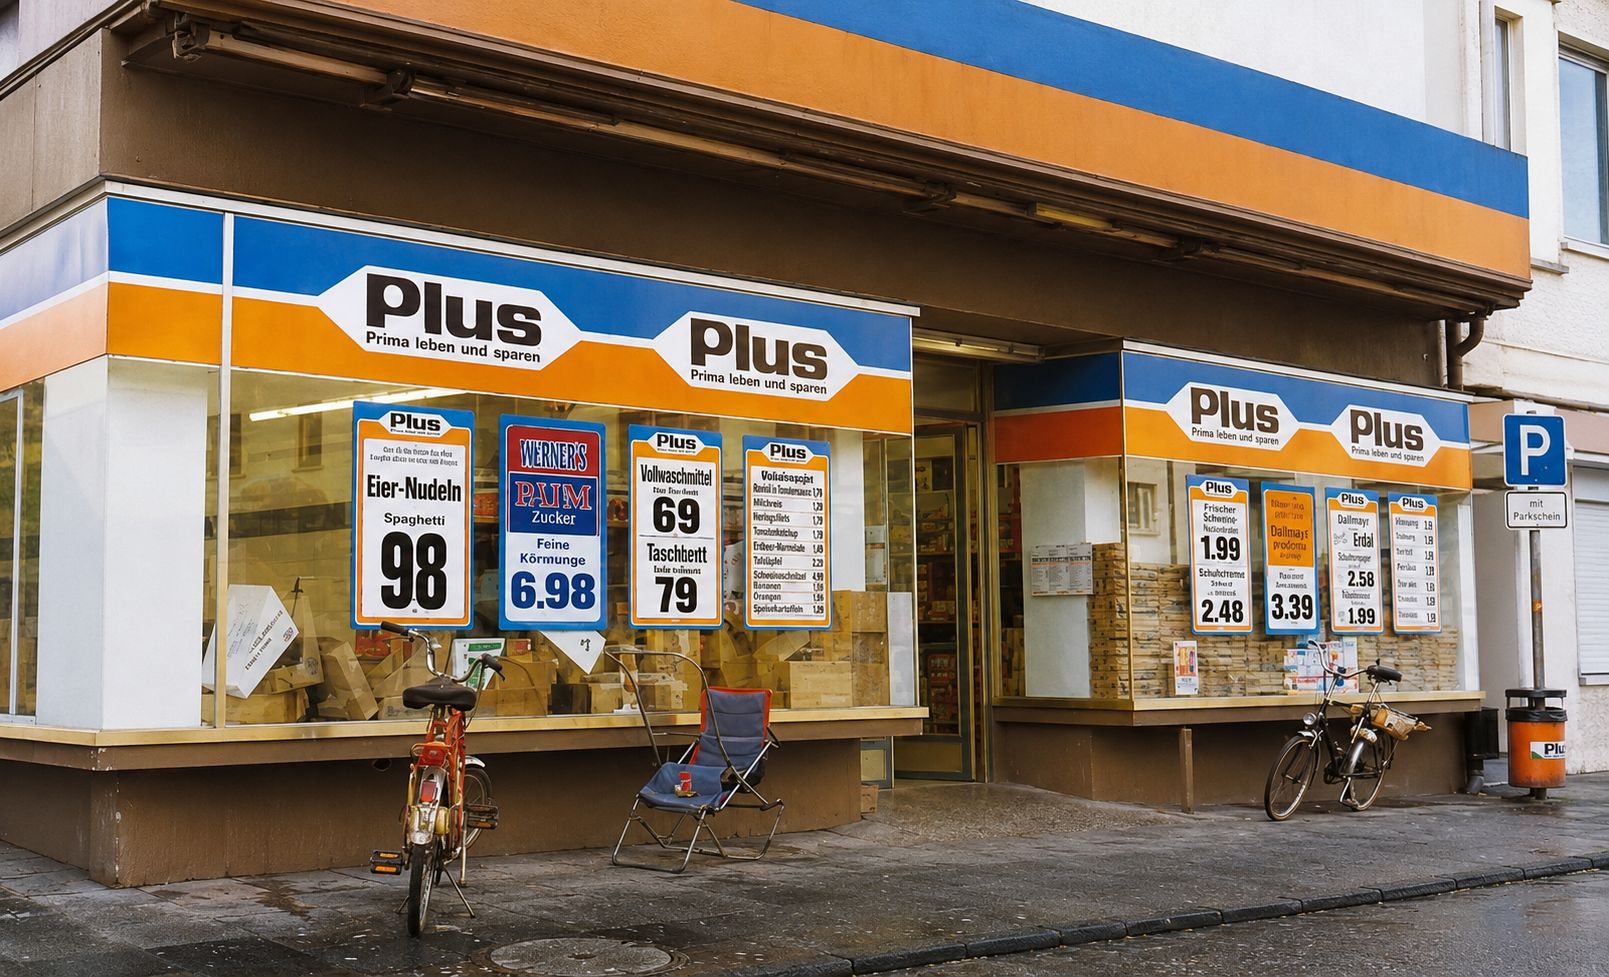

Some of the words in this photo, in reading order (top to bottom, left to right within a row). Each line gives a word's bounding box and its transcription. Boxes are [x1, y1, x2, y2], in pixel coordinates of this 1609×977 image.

[366, 273, 542, 347] Plus
[366, 331, 410, 349] Prima
[415, 336, 454, 354] leben
[461, 341, 487, 357] und
[493, 348, 541, 364] sparen
[690, 317, 828, 380] Plus
[690, 369, 725, 385] Prima
[729, 373, 760, 388] leben
[764, 377, 786, 391] und
[790, 383, 828, 395] sparen
[390, 412, 441, 431] Plus
[1190, 387, 1279, 434] Plus
[657, 434, 696, 450] Plus
[1192, 427, 1214, 438] Prima
[1216, 430, 1237, 441] leben
[1239, 432, 1253, 443] und
[1255, 436, 1279, 446] sparen
[1350, 409, 1424, 452] Plus
[520, 439, 587, 471] WERNER'S
[770, 444, 806, 459] Plus
[1351, 446, 1370, 456] Prima
[1371, 448, 1389, 459] leben
[1391, 450, 1402, 460] und
[1404, 453, 1424, 463] sparen
[1519, 424, 1551, 476] P
[640, 464, 712, 487] Vollwaschmittel
[367, 474, 462, 502] Eier-Nudeln
[1206, 481, 1232, 494] Plus
[1341, 493, 1364, 505] Plus
[1204, 503, 1236, 514] Frischer
[1402, 498, 1424, 508] Plus
[1529, 499, 1543, 508] mit
[384, 512, 445, 527] Spaghetti
[532, 511, 576, 525] Zucker
[653, 496, 700, 534] 69
[1513, 512, 1560, 520] Parkschein
[537, 538, 570, 550] Feine
[1201, 535, 1241, 561] 1.99
[381, 531, 447, 610] 98
[520, 553, 586, 567] Körmunge
[1347, 570, 1375, 587] 2.58
[511, 571, 596, 610] 6.98
[655, 576, 697, 613] 79
[1201, 599, 1244, 623] 2.48
[1271, 593, 1313, 620] 3.39
